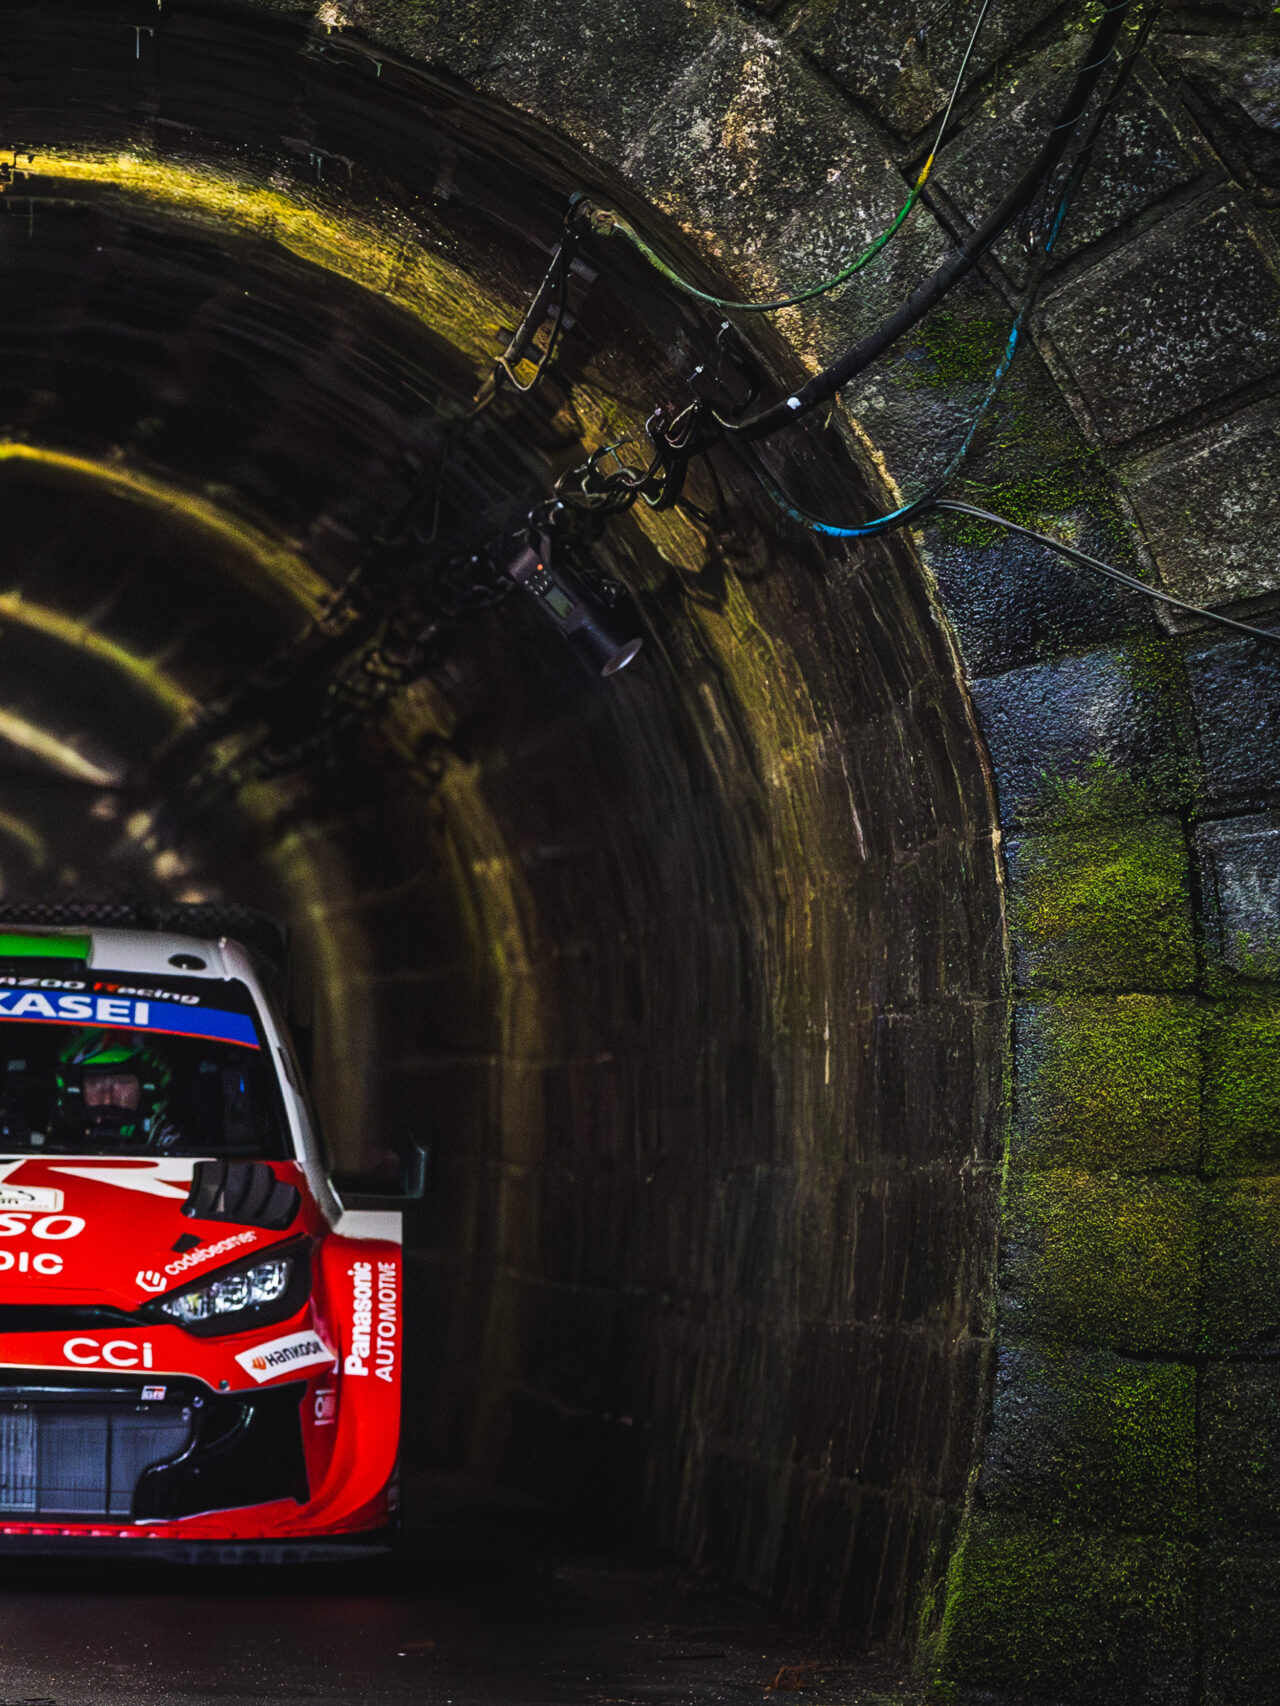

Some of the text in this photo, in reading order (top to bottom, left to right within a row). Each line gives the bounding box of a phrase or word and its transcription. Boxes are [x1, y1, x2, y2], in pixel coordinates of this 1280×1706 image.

[93, 981, 200, 1005] Racing
[344, 1262, 372, 1376] Panasonic
[375, 1262, 397, 1383] AUTOMOTIVE
